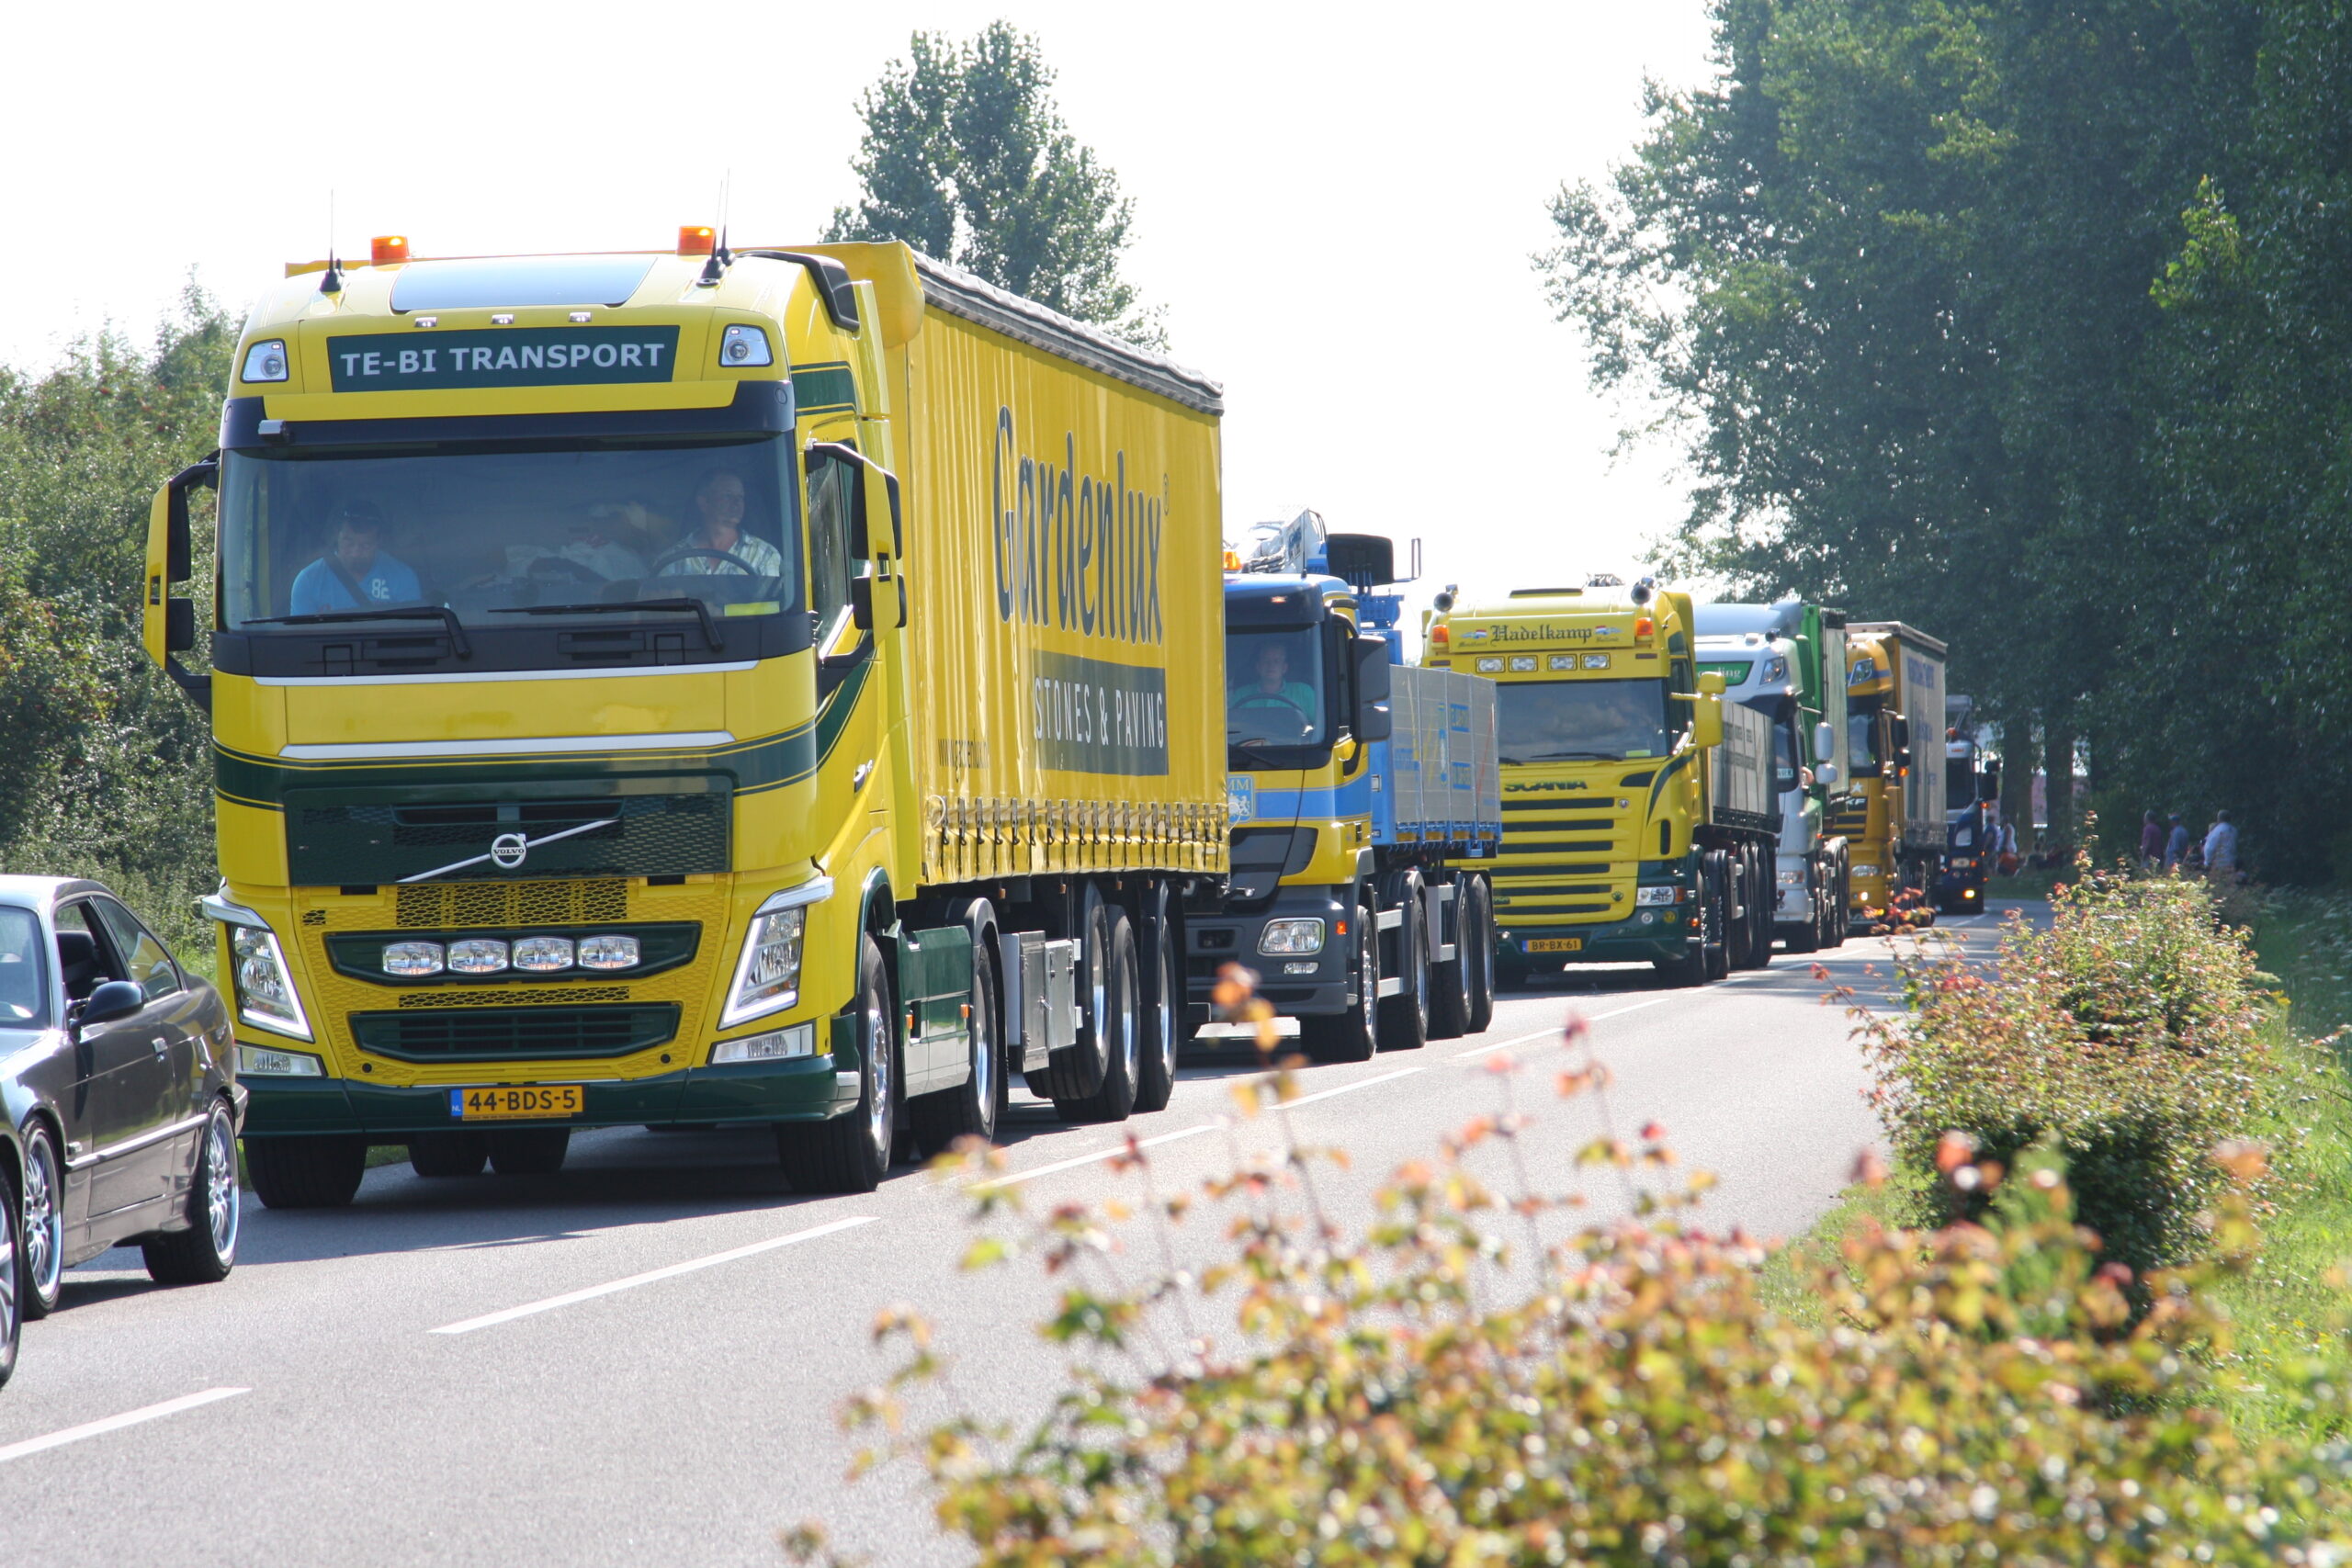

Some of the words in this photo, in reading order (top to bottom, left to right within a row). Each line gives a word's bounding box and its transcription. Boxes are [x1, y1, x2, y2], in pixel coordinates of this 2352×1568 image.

[340, 349, 436, 377] TE-BI
[449, 344, 665, 372] TRANSPORT
[993, 404, 1163, 647] Gardenlux
[1489, 624, 1592, 646] Hadelkamp
[1035, 676, 1091, 744] STONES
[1099, 686, 1109, 746] &
[1115, 688, 1164, 749] PAVING
[469, 1089, 576, 1111] 44-BDS-5
